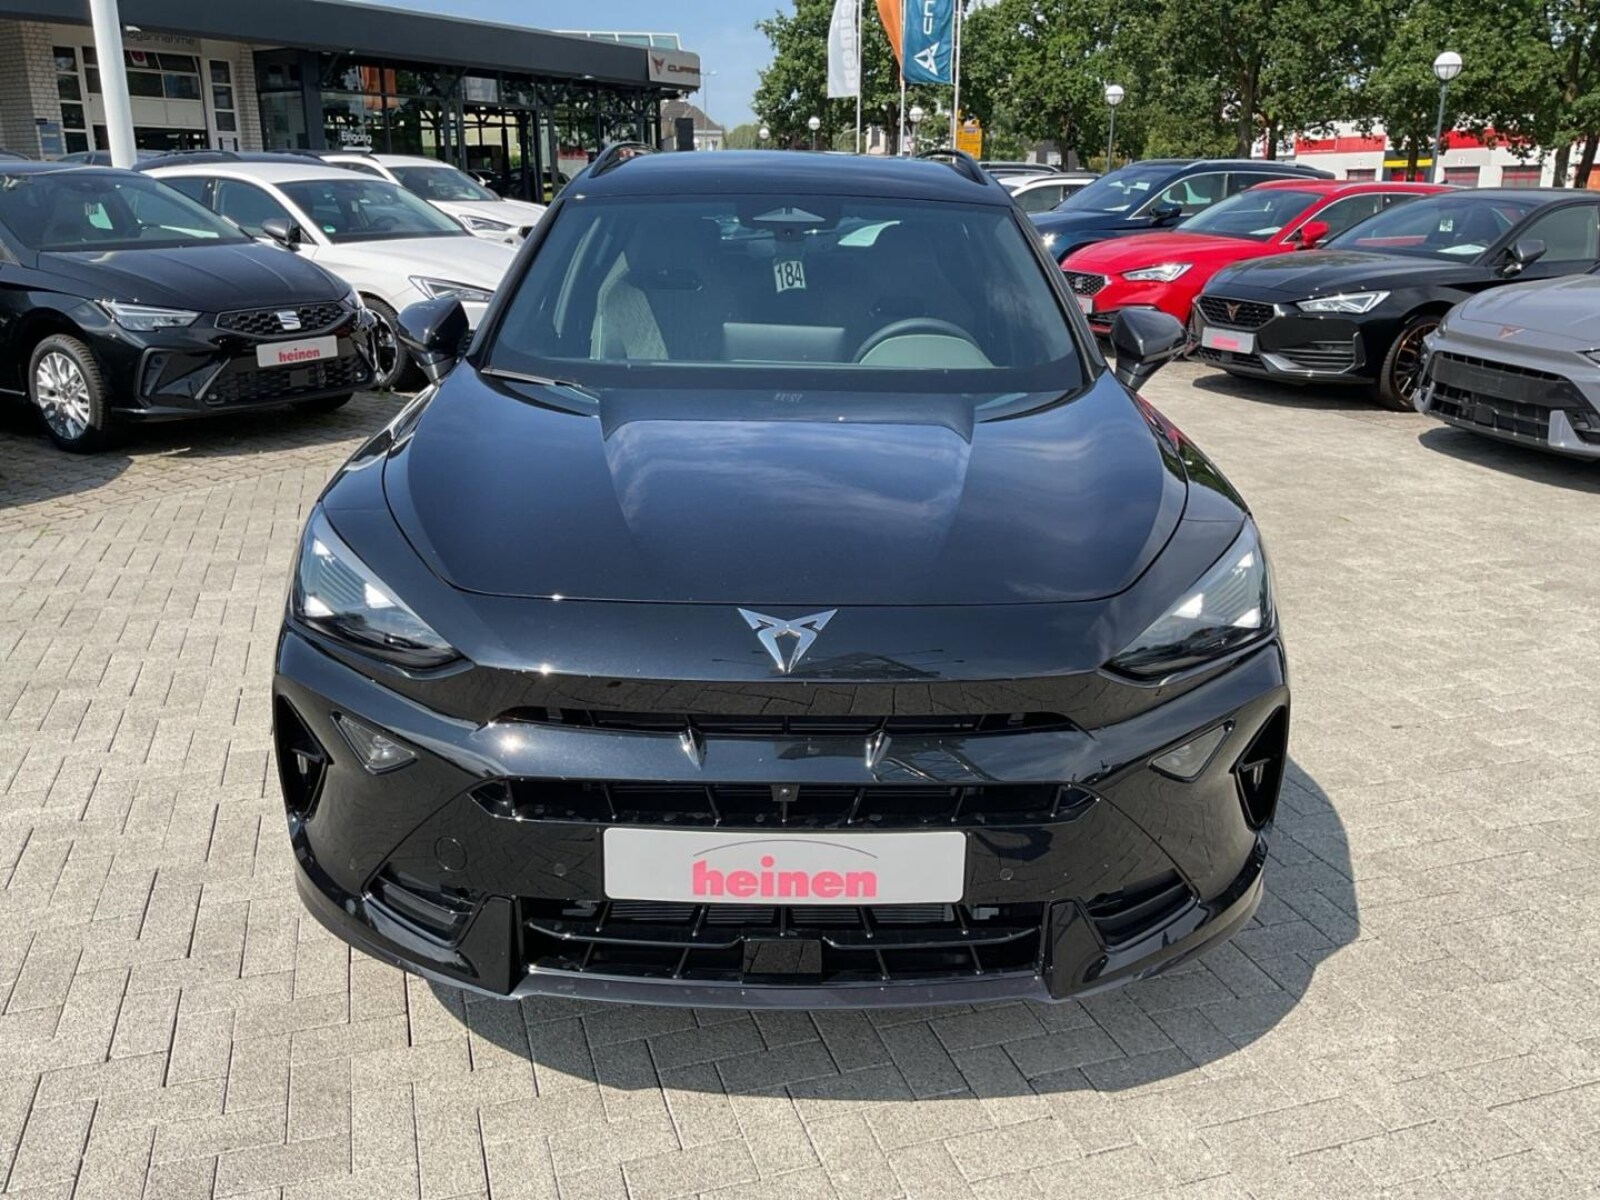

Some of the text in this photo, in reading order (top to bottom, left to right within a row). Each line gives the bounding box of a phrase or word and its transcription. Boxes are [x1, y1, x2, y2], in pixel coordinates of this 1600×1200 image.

[777, 262, 804, 289] 184
[278, 346, 321, 363] heinen
[692, 855, 877, 898] heinen
